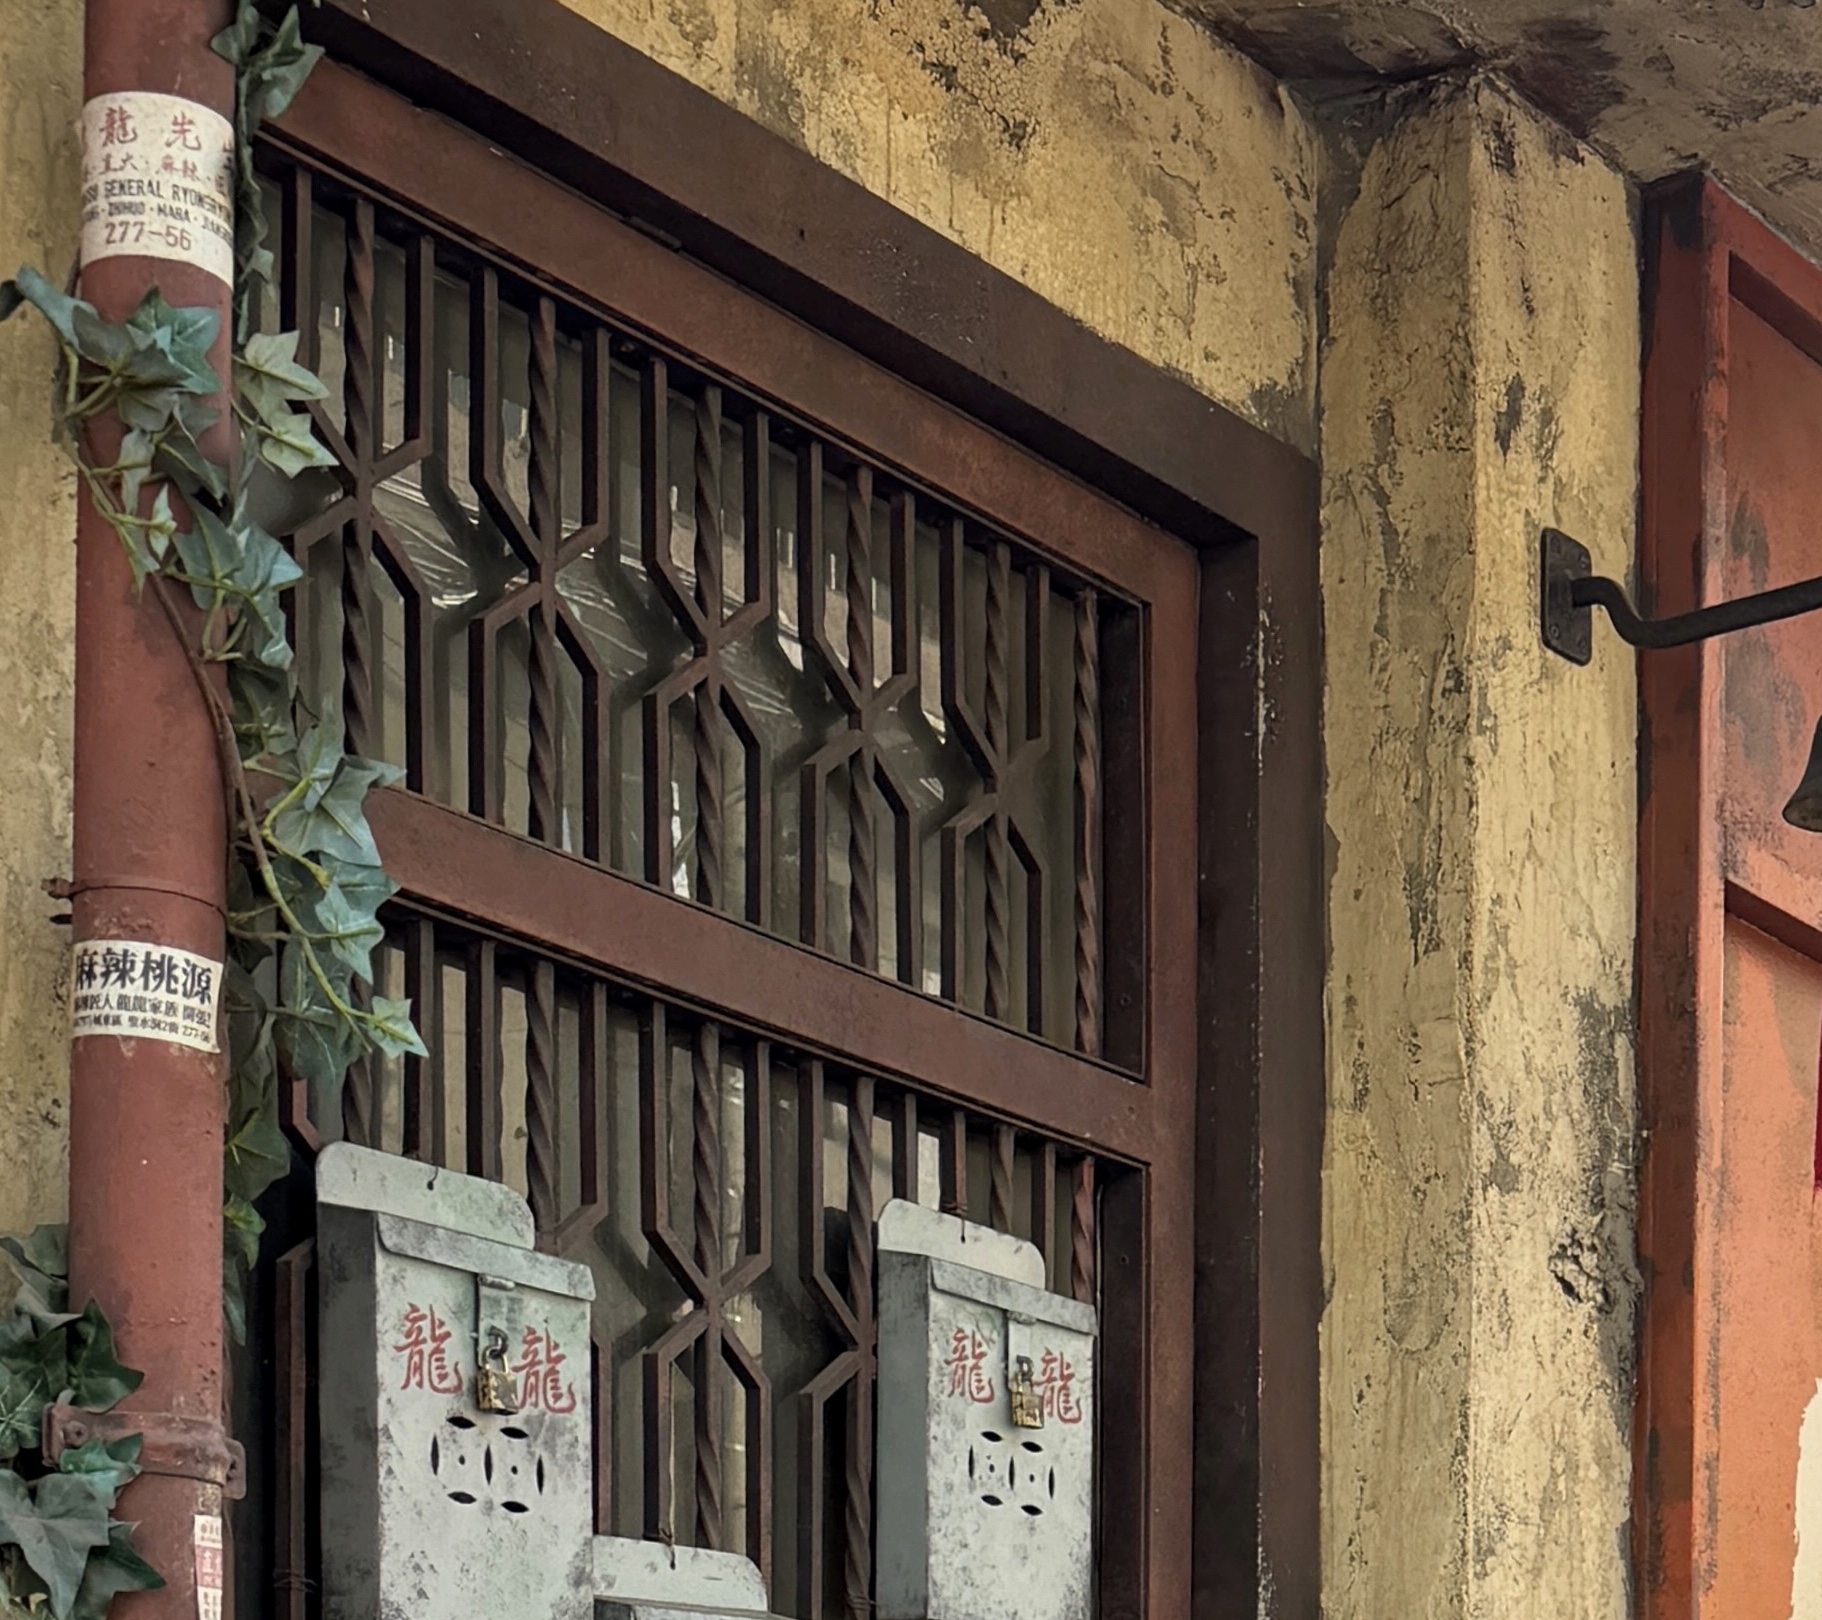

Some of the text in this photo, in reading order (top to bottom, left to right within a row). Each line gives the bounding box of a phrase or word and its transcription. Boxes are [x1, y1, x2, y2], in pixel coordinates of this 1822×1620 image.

[105, 220, 193, 252] 277-56
[76, 946, 213, 1005] 麻辣桃源
[393, 1302, 576, 1413] 龍 龍
[944, 1326, 1082, 1424] 龍 龍
